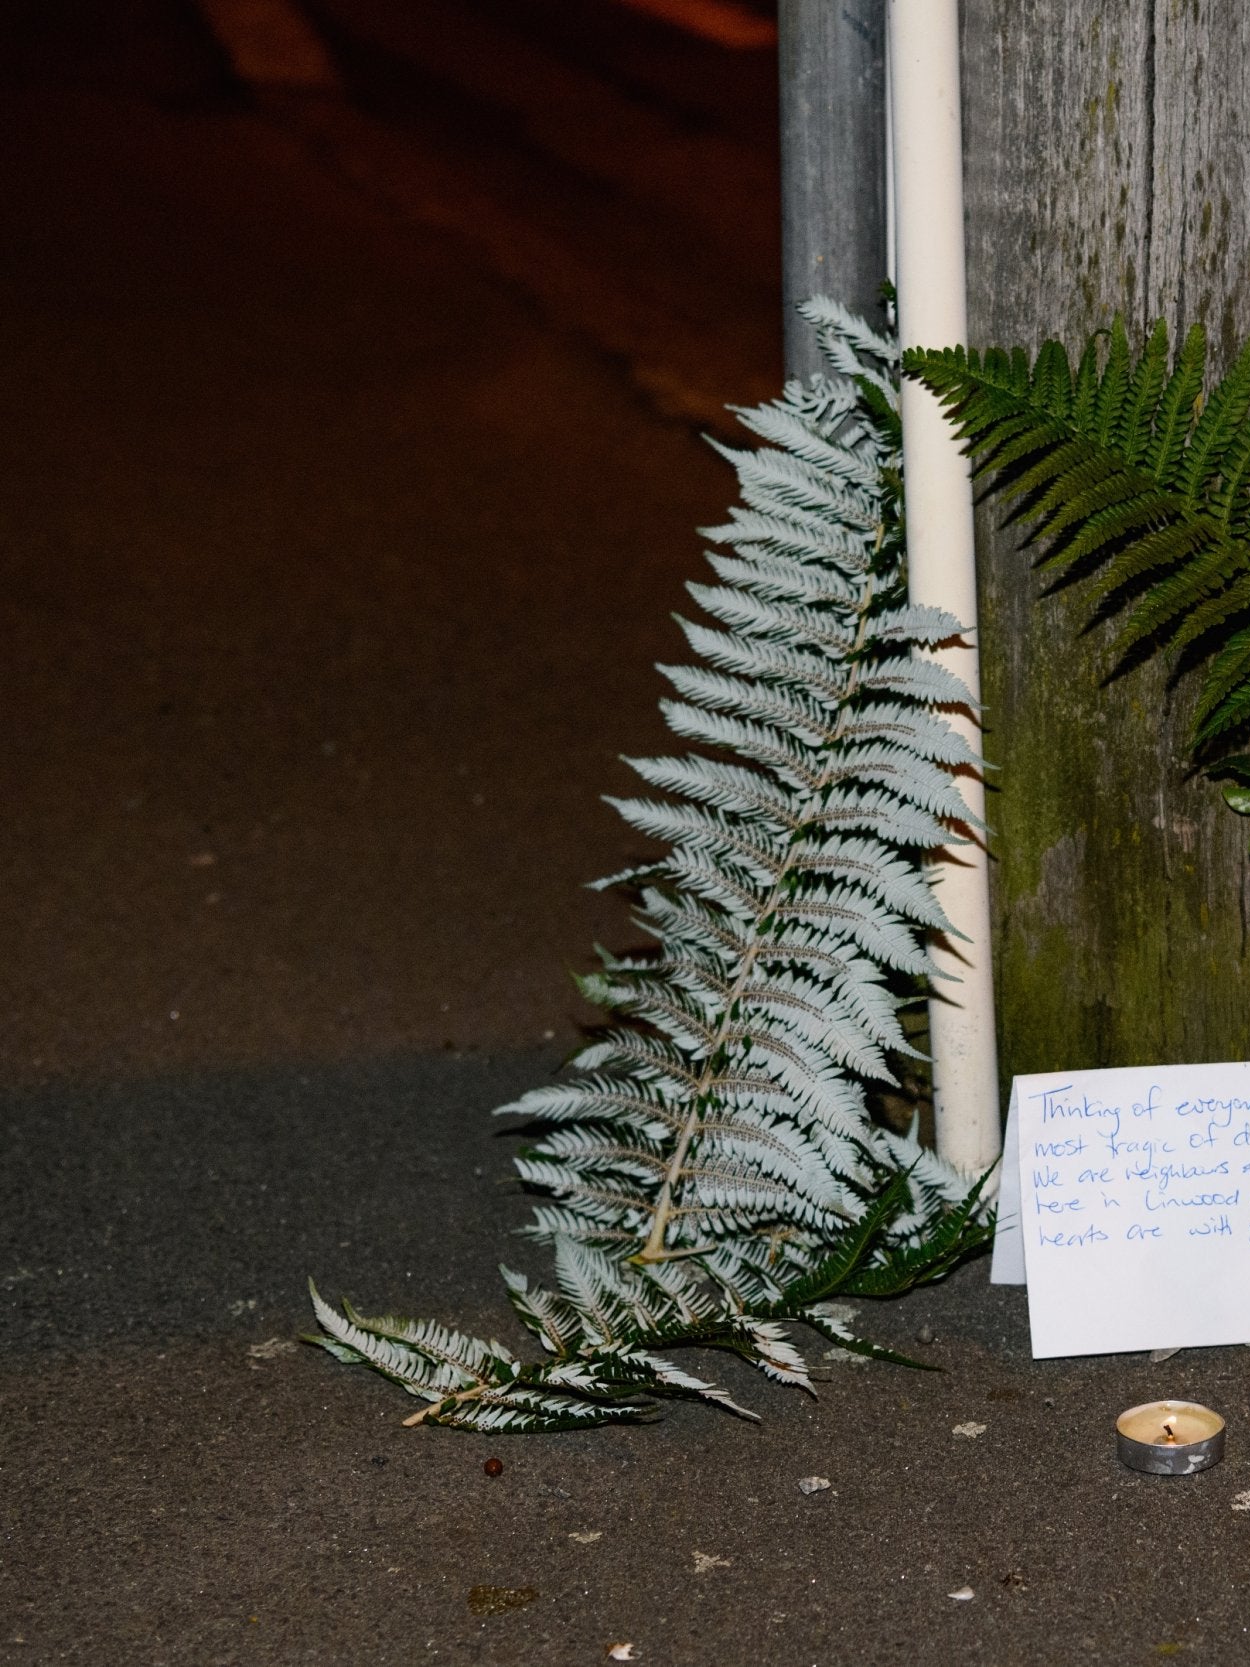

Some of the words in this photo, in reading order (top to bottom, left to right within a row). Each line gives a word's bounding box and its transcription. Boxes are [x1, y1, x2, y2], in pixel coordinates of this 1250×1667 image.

[1028, 1085, 1120, 1138] Thinking
[1132, 1086, 1161, 1120] of
[1035, 1135, 1088, 1157] most
[1106, 1132, 1177, 1172] tragic
[1189, 1123, 1219, 1147] of
[1033, 1165, 1063, 1188] We
[1078, 1168, 1114, 1184] are
[1036, 1192, 1086, 1214] here
[1101, 1192, 1120, 1207] in
[1039, 1224, 1109, 1246] hearts
[1126, 1224, 1163, 1240] are
[1189, 1215, 1232, 1235] with
